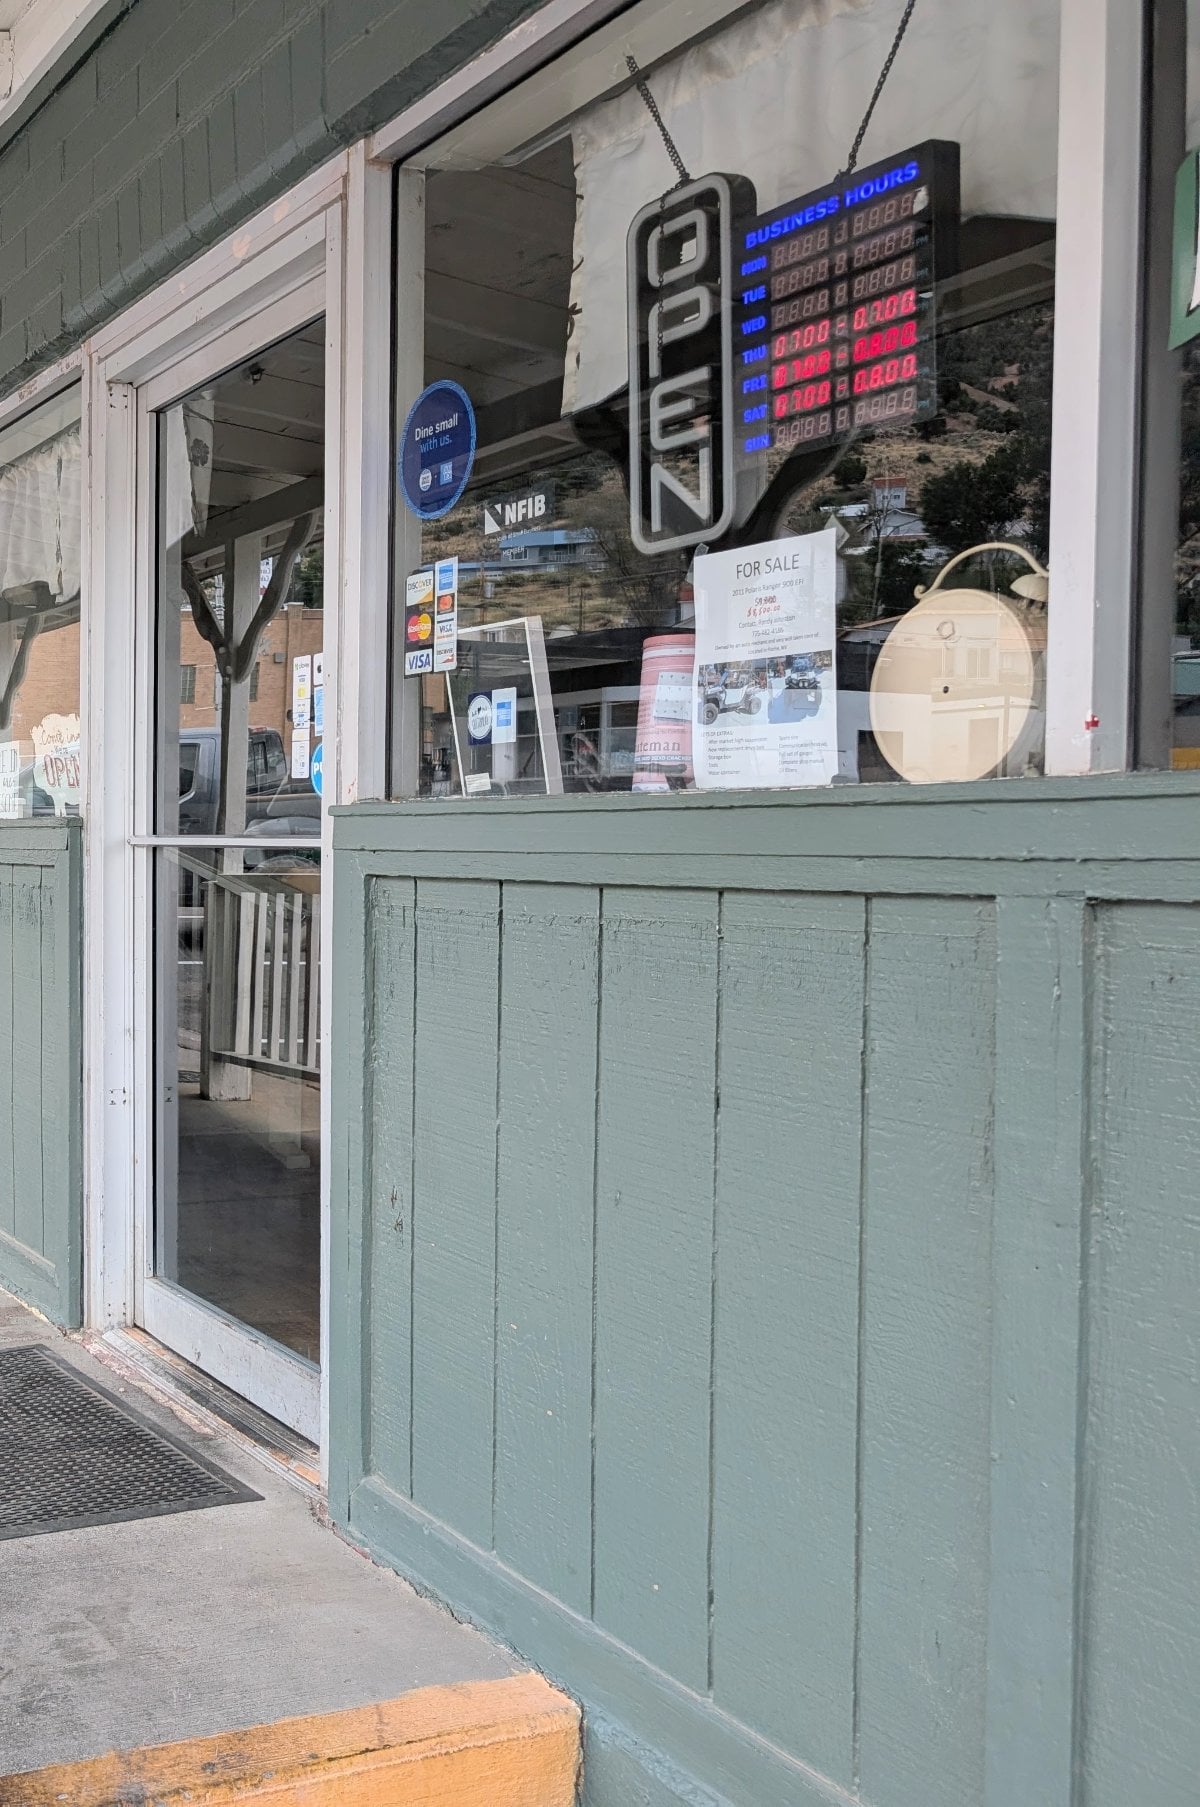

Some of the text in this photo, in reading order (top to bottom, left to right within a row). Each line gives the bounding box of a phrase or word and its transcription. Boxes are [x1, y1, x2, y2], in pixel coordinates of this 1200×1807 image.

[745, 161, 920, 249] BUSINESS HOURS
[741, 256, 767, 276] MON
[742, 286, 766, 305] TUE
[741, 316, 766, 335] WED
[742, 345, 767, 365] THU
[647, 209, 711, 533] OPEN
[743, 375, 767, 394] FRI
[743, 404, 768, 423] SAT
[415, 413, 458, 440] Dine small
[420, 434, 452, 453] with us.
[744, 434, 770, 453] SUN
[505, 494, 546, 525] NFIB
[736, 553, 799, 579] FOR SALE
[440, 624, 452, 633] VISA
[409, 653, 431, 670] VISA
